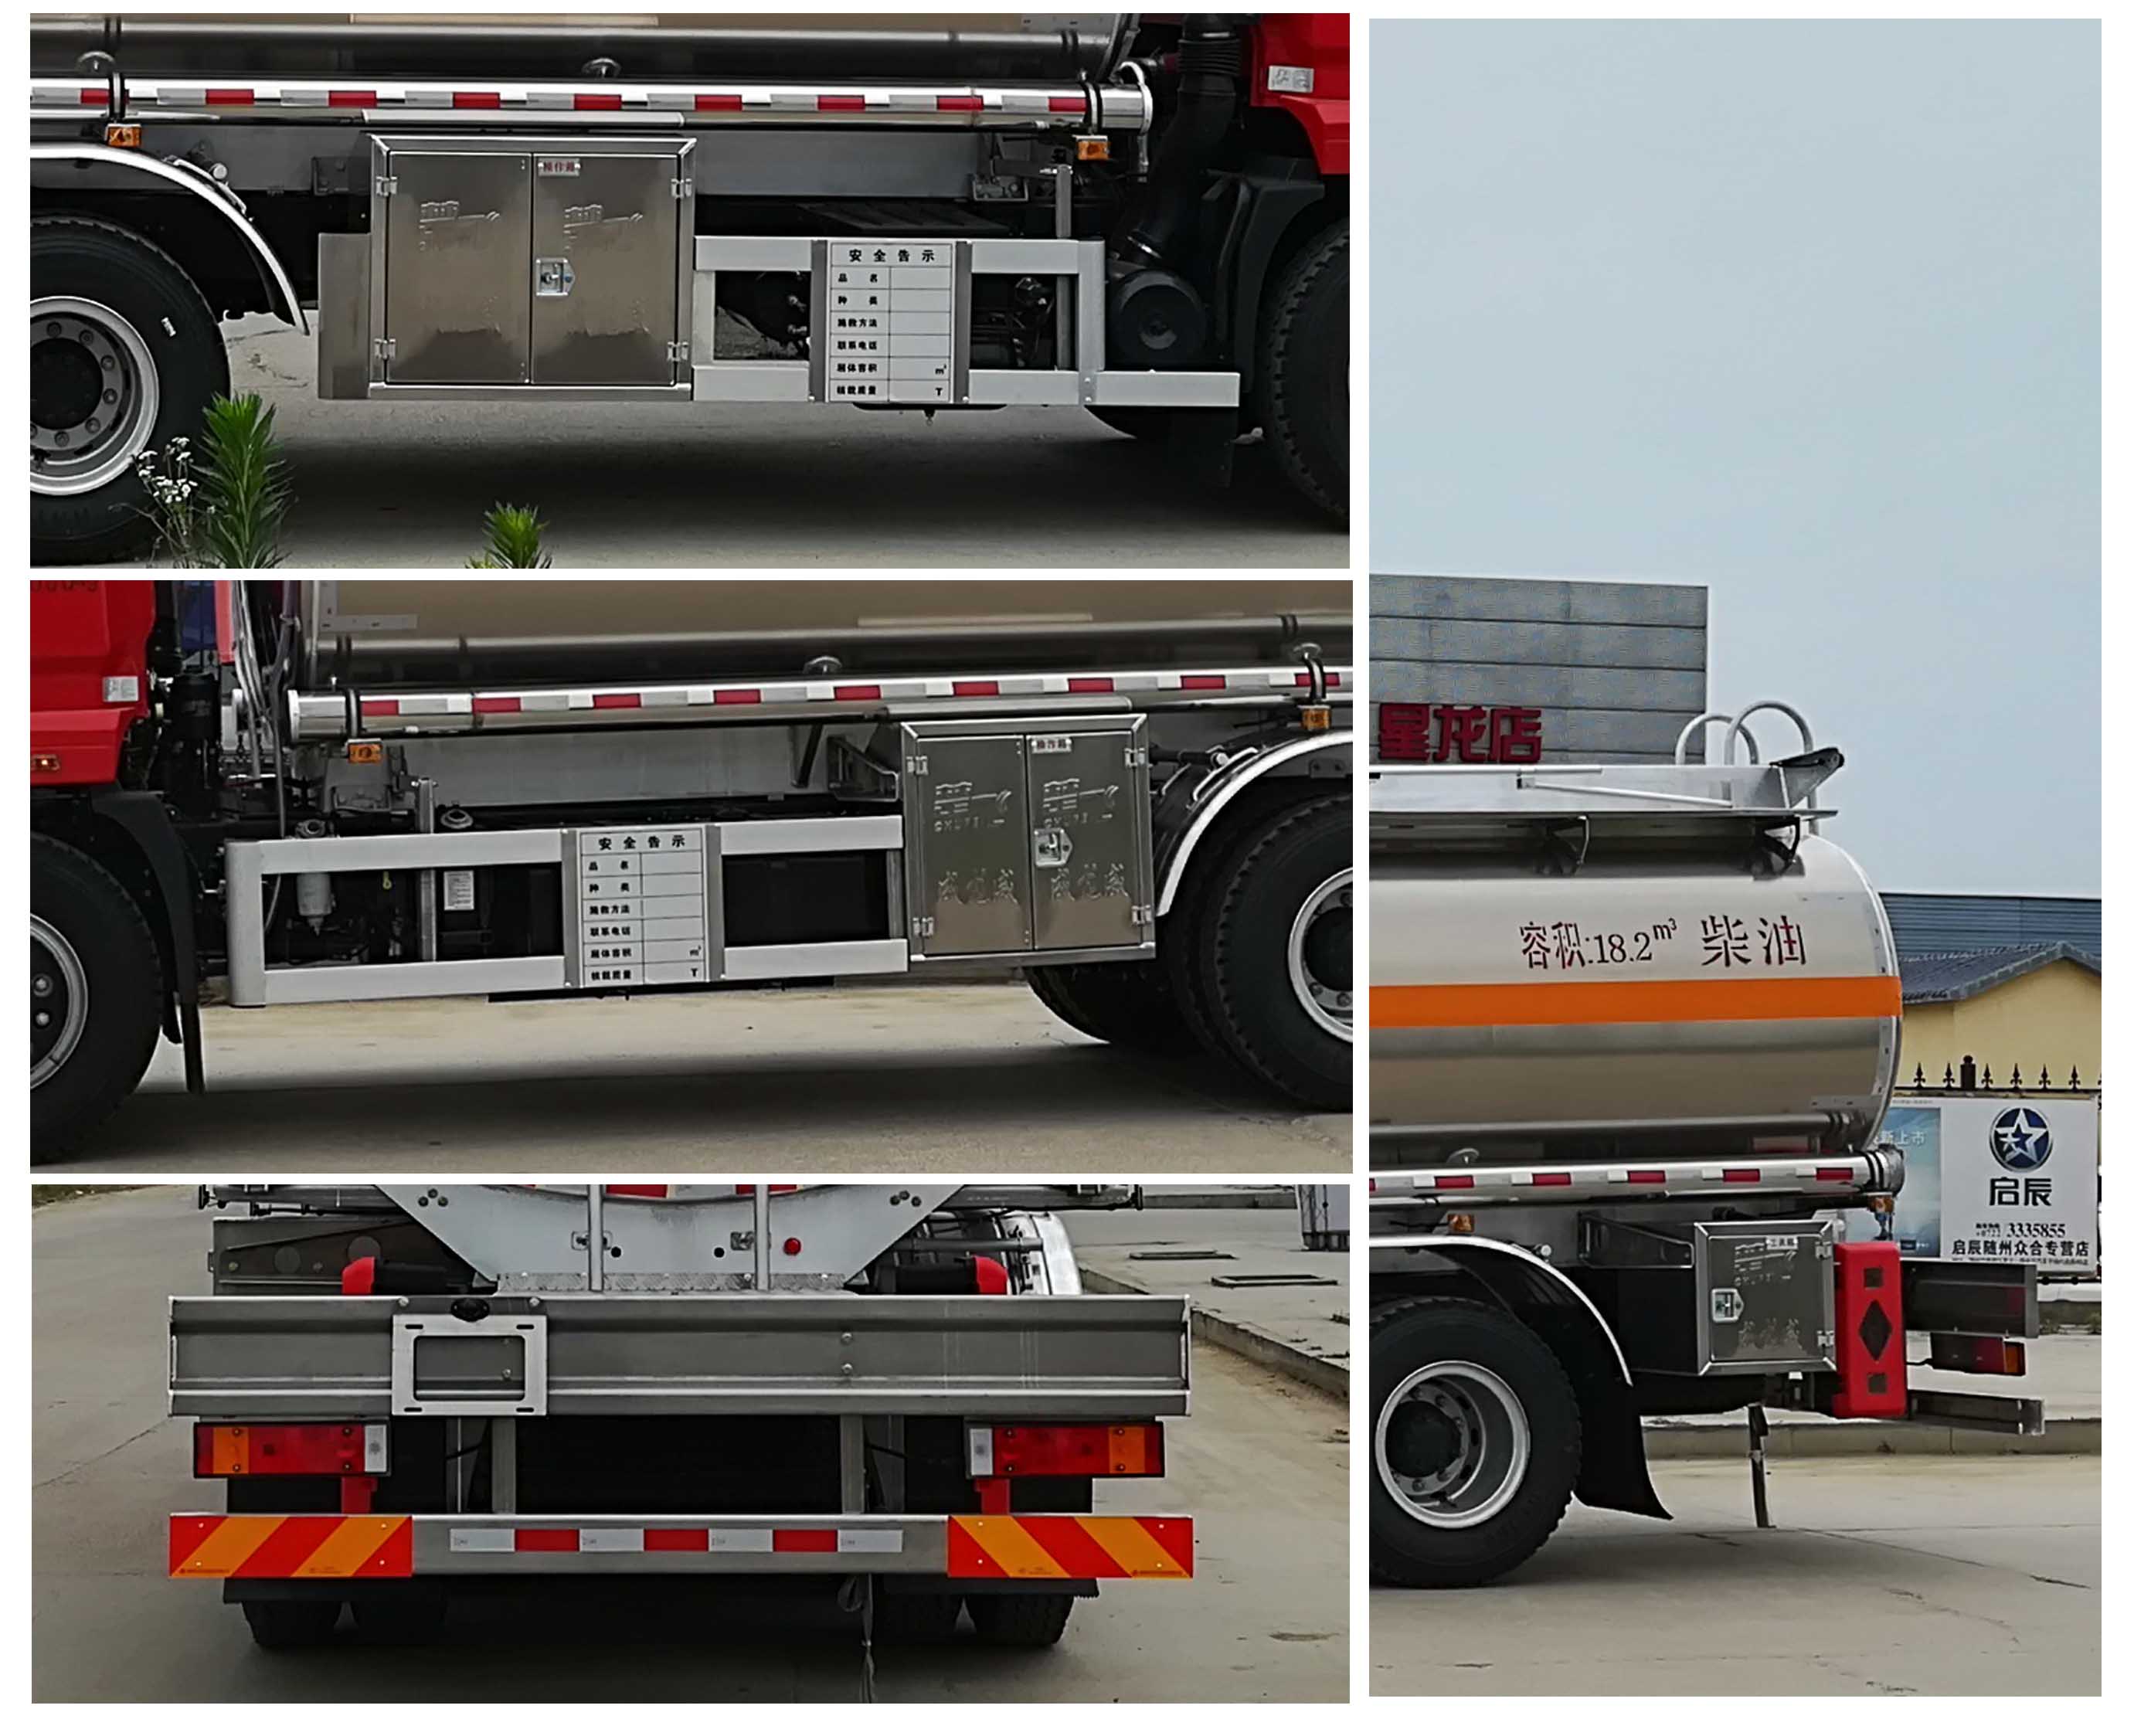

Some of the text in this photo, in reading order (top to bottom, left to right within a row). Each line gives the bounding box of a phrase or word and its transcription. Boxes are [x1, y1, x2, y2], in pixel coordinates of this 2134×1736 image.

[849, 249, 935, 262] 安全告示
[935, 387, 943, 396] T
[1379, 703, 1542, 764] 星龙店
[598, 834, 685, 851] 安全告示
[1700, 915, 1806, 967] 柴油
[691, 967, 698, 977] T
[1990, 1177, 2052, 1206] 启辰
[2008, 1222, 2066, 1238] 3335855
[1952, 1239, 2090, 1257] 启辰随州众合专营店
